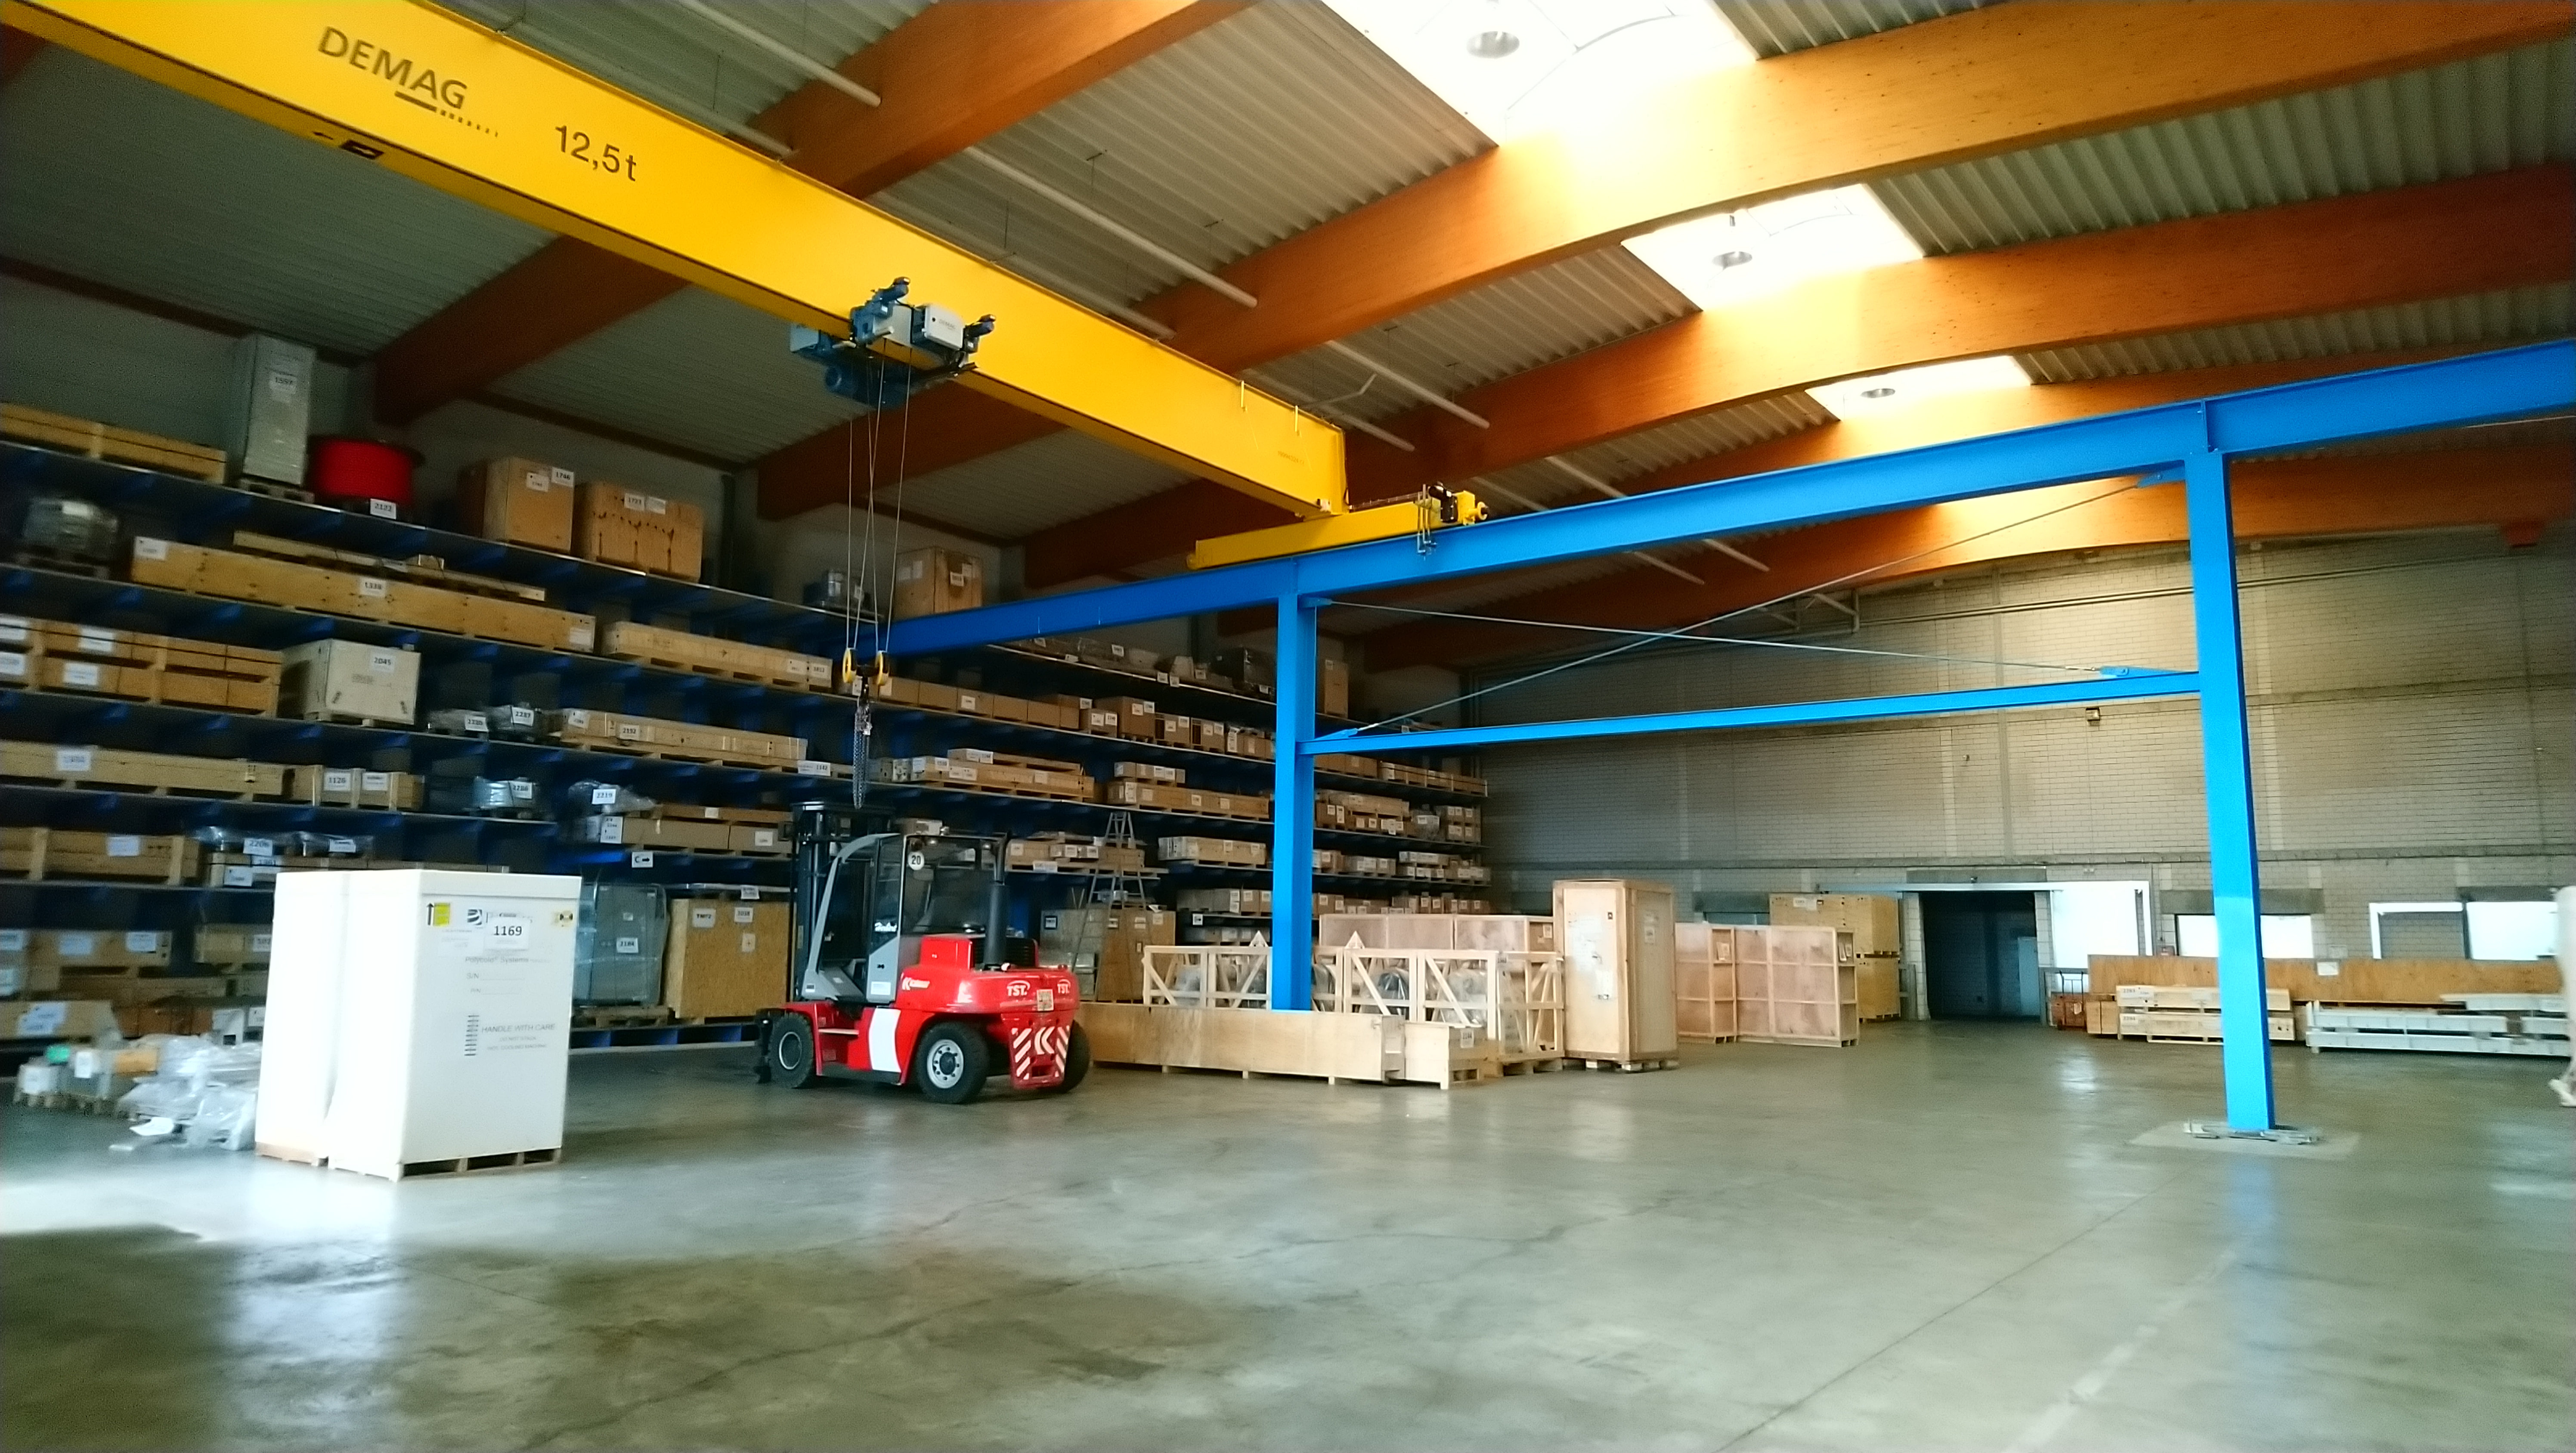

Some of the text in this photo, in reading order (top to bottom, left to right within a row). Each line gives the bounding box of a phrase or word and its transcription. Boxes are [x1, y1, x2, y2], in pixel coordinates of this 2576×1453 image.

[318, 26, 468, 110] DEMAG
[374, 657, 392, 665] 2045
[911, 855, 921, 865] 20
[493, 926, 523, 937] 1169
[481, 1025, 512, 1033] HANDLE
[514, 1023, 533, 1032] WITH
